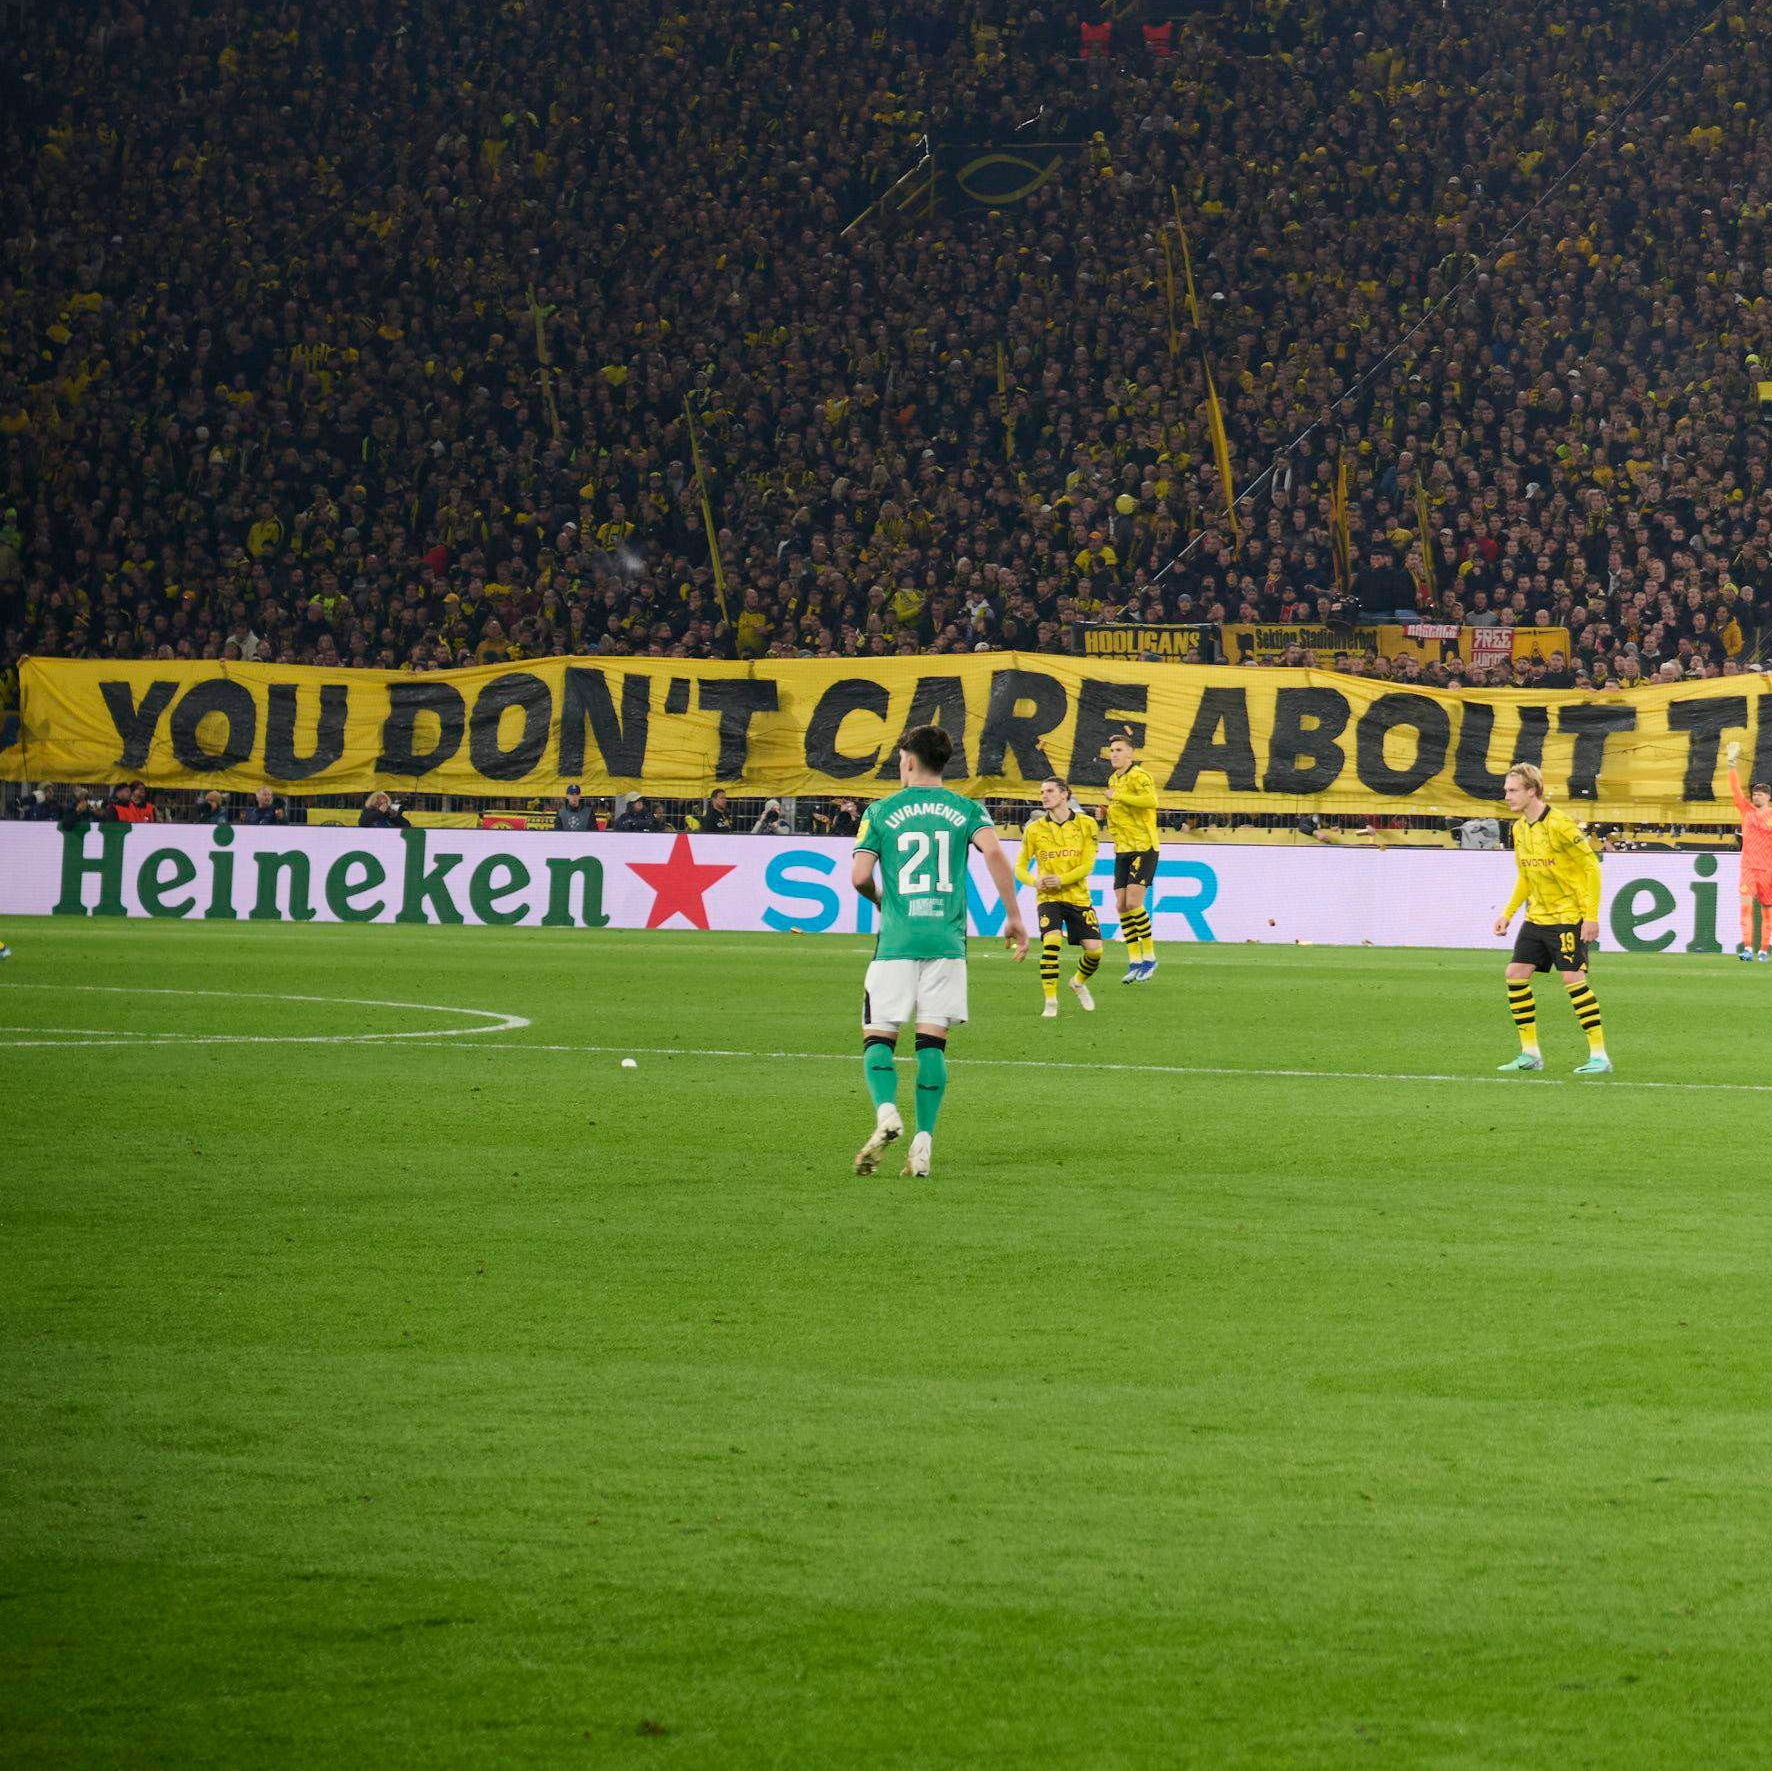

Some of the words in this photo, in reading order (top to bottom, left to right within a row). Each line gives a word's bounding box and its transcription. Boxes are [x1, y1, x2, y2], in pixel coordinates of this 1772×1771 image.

[1085, 630, 1200, 655] HOOLIGANS
[1256, 628, 1298, 649] Sektion
[1474, 629, 1512, 649] FREE
[98, 678, 349, 782] YOU
[377, 671, 780, 784] DON'T
[805, 669, 1150, 790] CARE
[1163, 683, 1637, 801] ABOUT
[885, 802, 967, 829] LIVRAMENTO
[52, 821, 609, 928] Heineken
[897, 831, 953, 895] 21
[1132, 855, 1142, 871] 4
[1083, 909, 1099, 925] 20
[1559, 931, 1576, 953] 19
